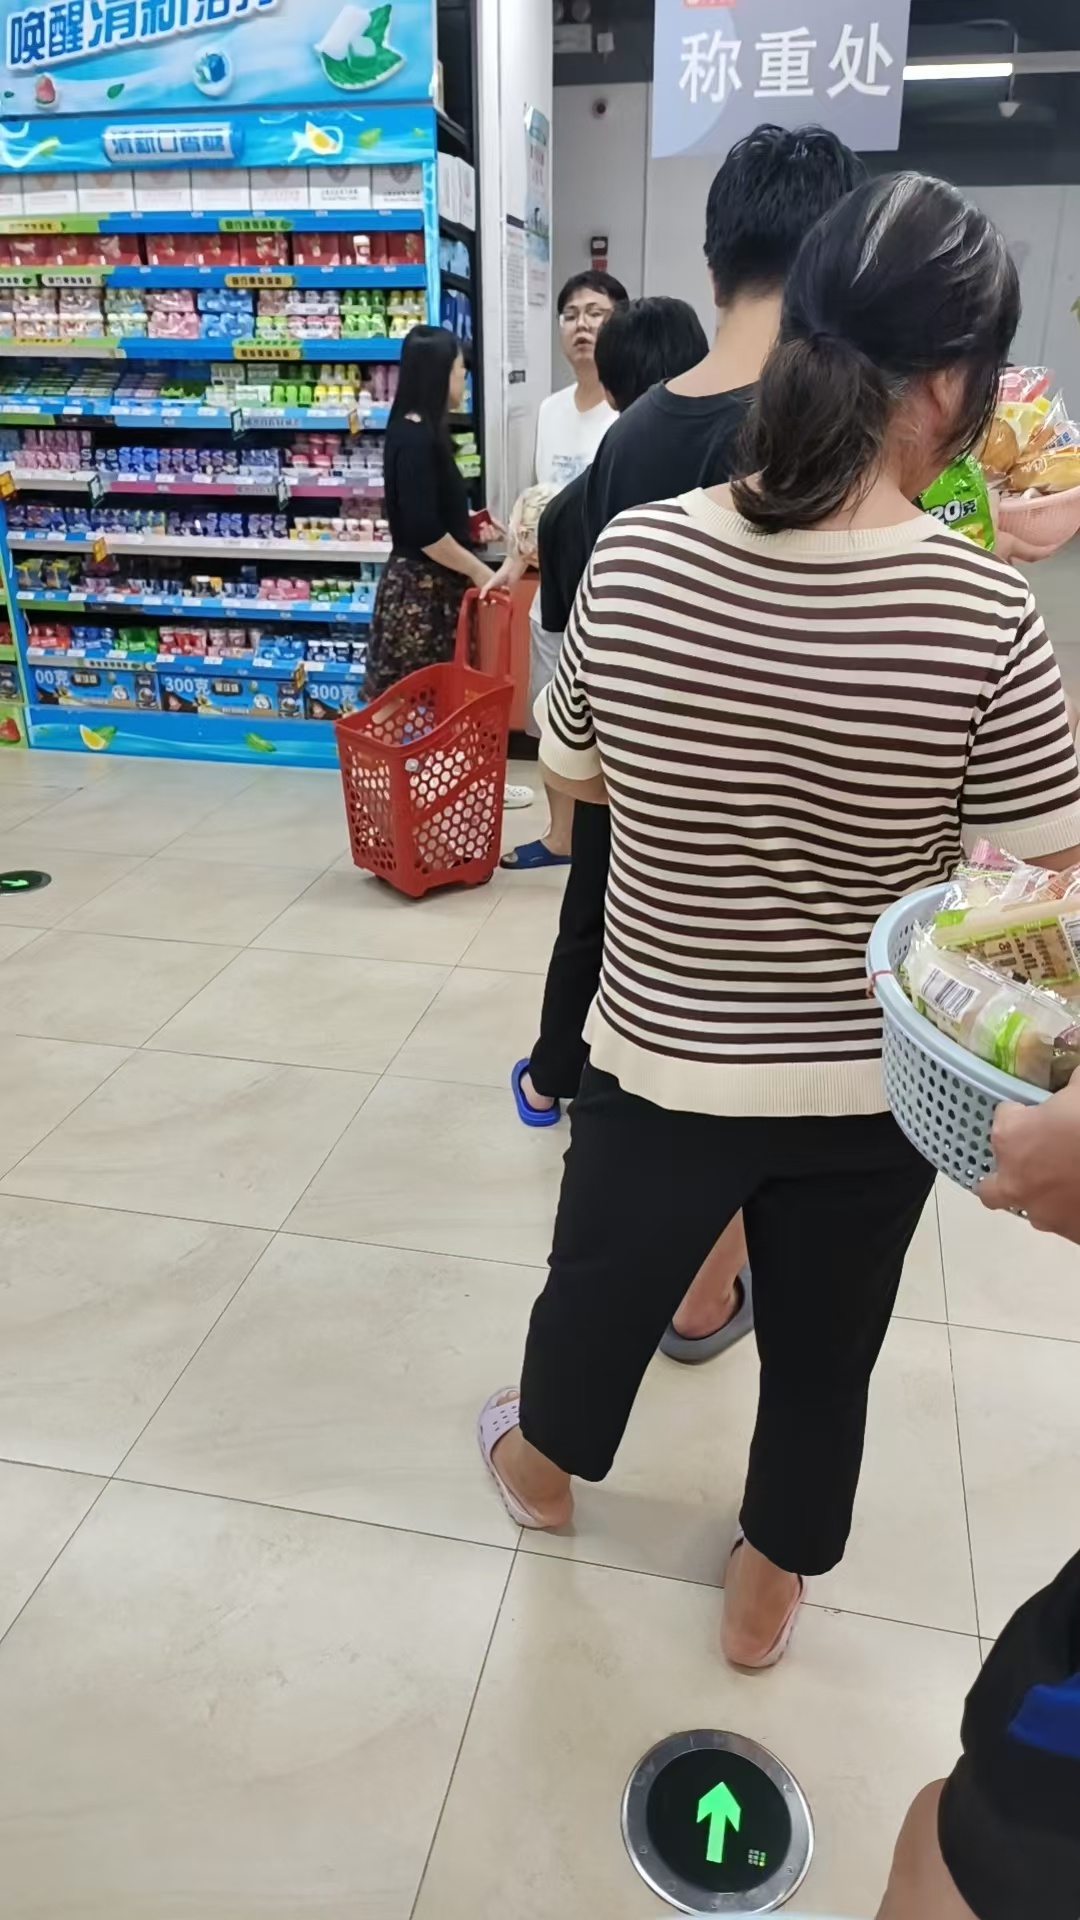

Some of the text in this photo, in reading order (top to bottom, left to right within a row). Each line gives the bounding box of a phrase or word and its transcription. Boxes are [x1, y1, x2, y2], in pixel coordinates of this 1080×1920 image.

[10, 0, 274, 65] 唤醒清新
[679, 22, 893, 103] 称重处
[925, 499, 977, 525] 20克
[165, 677, 210, 696] 300克
